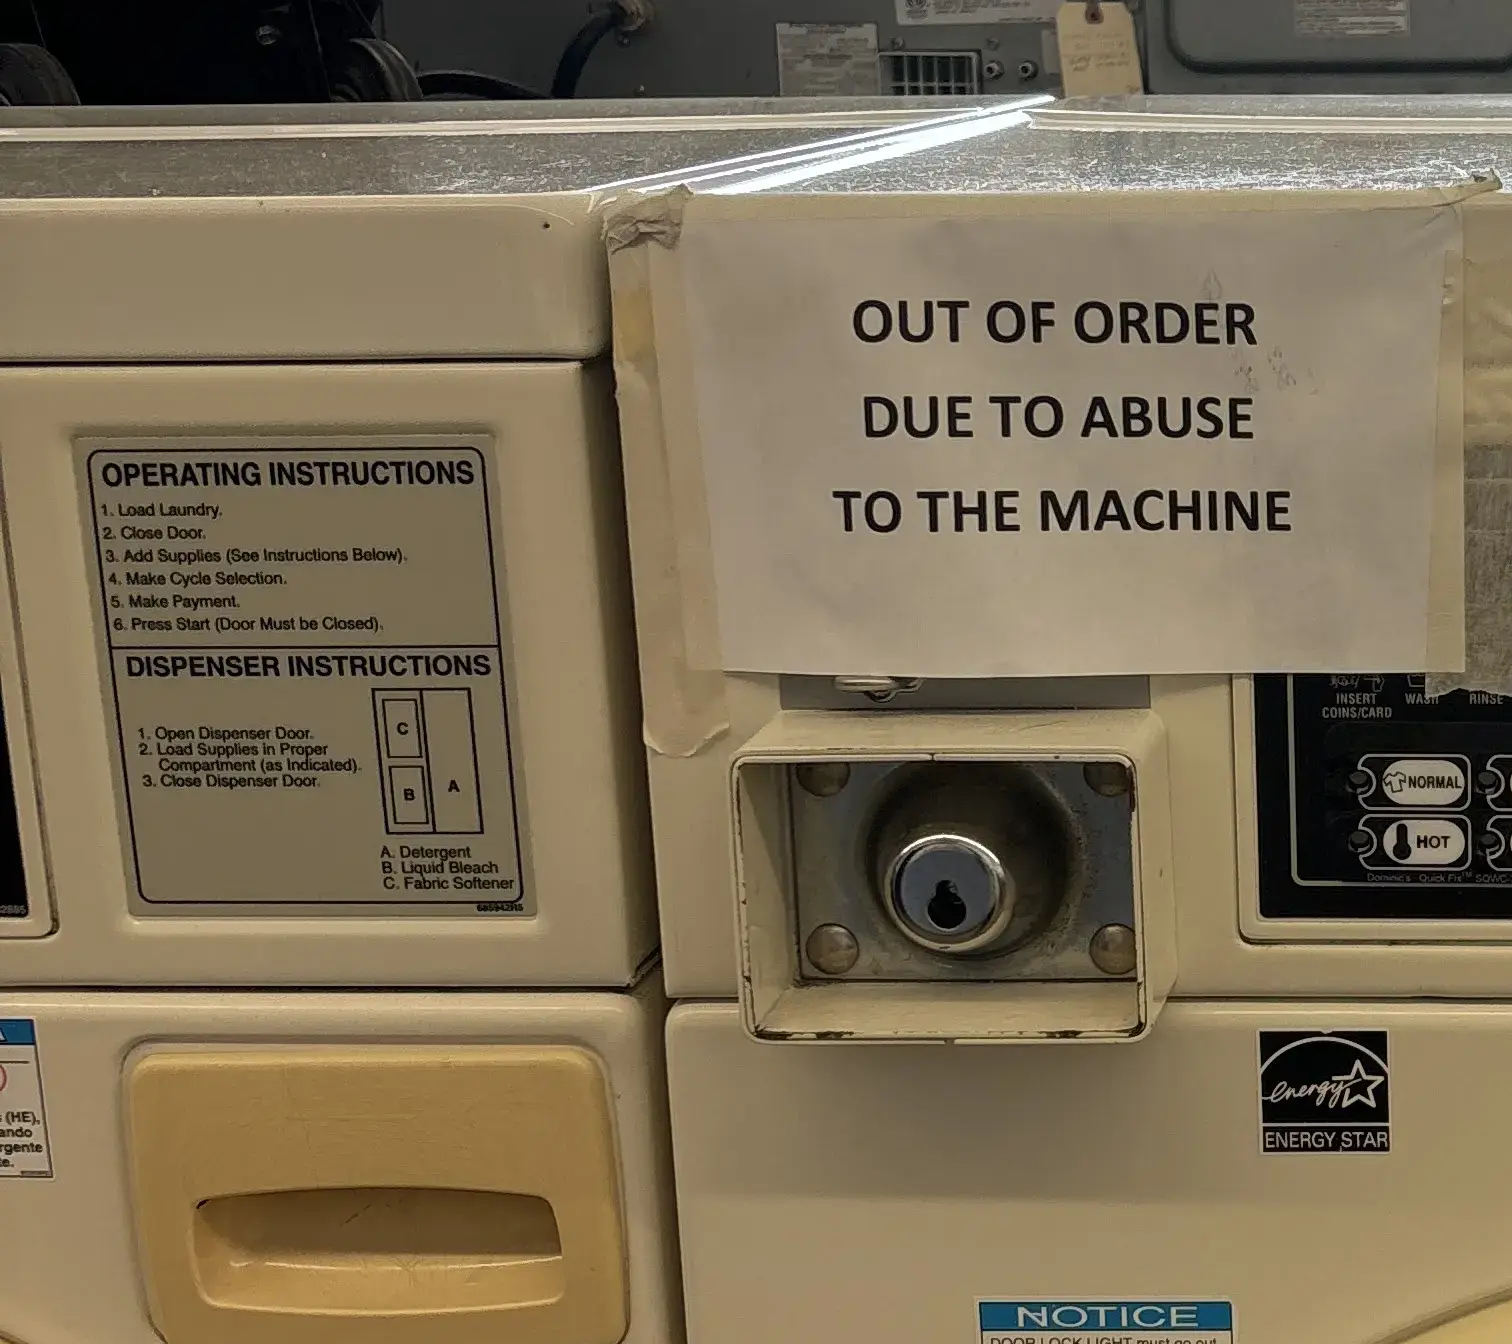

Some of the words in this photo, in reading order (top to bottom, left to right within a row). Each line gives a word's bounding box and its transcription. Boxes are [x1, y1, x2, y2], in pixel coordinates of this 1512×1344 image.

[853, 300, 969, 343] OUT
[987, 301, 1055, 343] OF
[1075, 301, 1257, 345] ORDER
[864, 396, 973, 438] DUE
[989, 396, 1063, 437] TO
[1081, 396, 1253, 439] ABUSE
[102, 462, 261, 487] OPERATING
[269, 460, 474, 486] INSTRUCTIONS
[101, 504, 114, 516] 1.
[118, 504, 155, 516] Load
[160, 503, 222, 519] Laundry.
[833, 491, 901, 533] TO
[917, 491, 1020, 532] THE
[1041, 490, 1291, 531] MACHINE
[103, 527, 116, 539] 2.
[121, 526, 163, 540] Close
[167, 526, 206, 539] Door.
[106, 549, 119, 562] 3.
[124, 549, 153, 562] Add
[158, 549, 221, 565] Supplies
[226, 548, 259, 565] (See
[264, 548, 348, 561] Instructions
[353, 548, 408, 564] Below).
[109, 572, 122, 585] 4.
[126, 572, 166, 585] Make
[170, 572, 211, 588] Cycle
[216, 571, 287, 585] Selection.
[113, 618, 128, 630] 6.
[132, 618, 172, 631] Press
[176, 617, 210, 631] Start
[215, 617, 256, 634] (Door
[260, 617, 295, 630] Must
[299, 617, 318, 630] be
[322, 617, 383, 633] Closed).
[1337, 694, 1377, 704] INSERT
[1469, 692, 1504, 705] RINSE
[1322, 707, 1392, 718] COINS/CARD
[1409, 776, 1462, 789] NORMAL
[1417, 835, 1450, 848] HOT
[1419, 874, 1445, 882] Quick
[1264, 1080, 1346, 1109] energy
[1265, 1132, 1336, 1148] ENERGY
[1340, 1131, 1388, 1148] STAR
[1018, 1306, 1198, 1327] NOTICE
